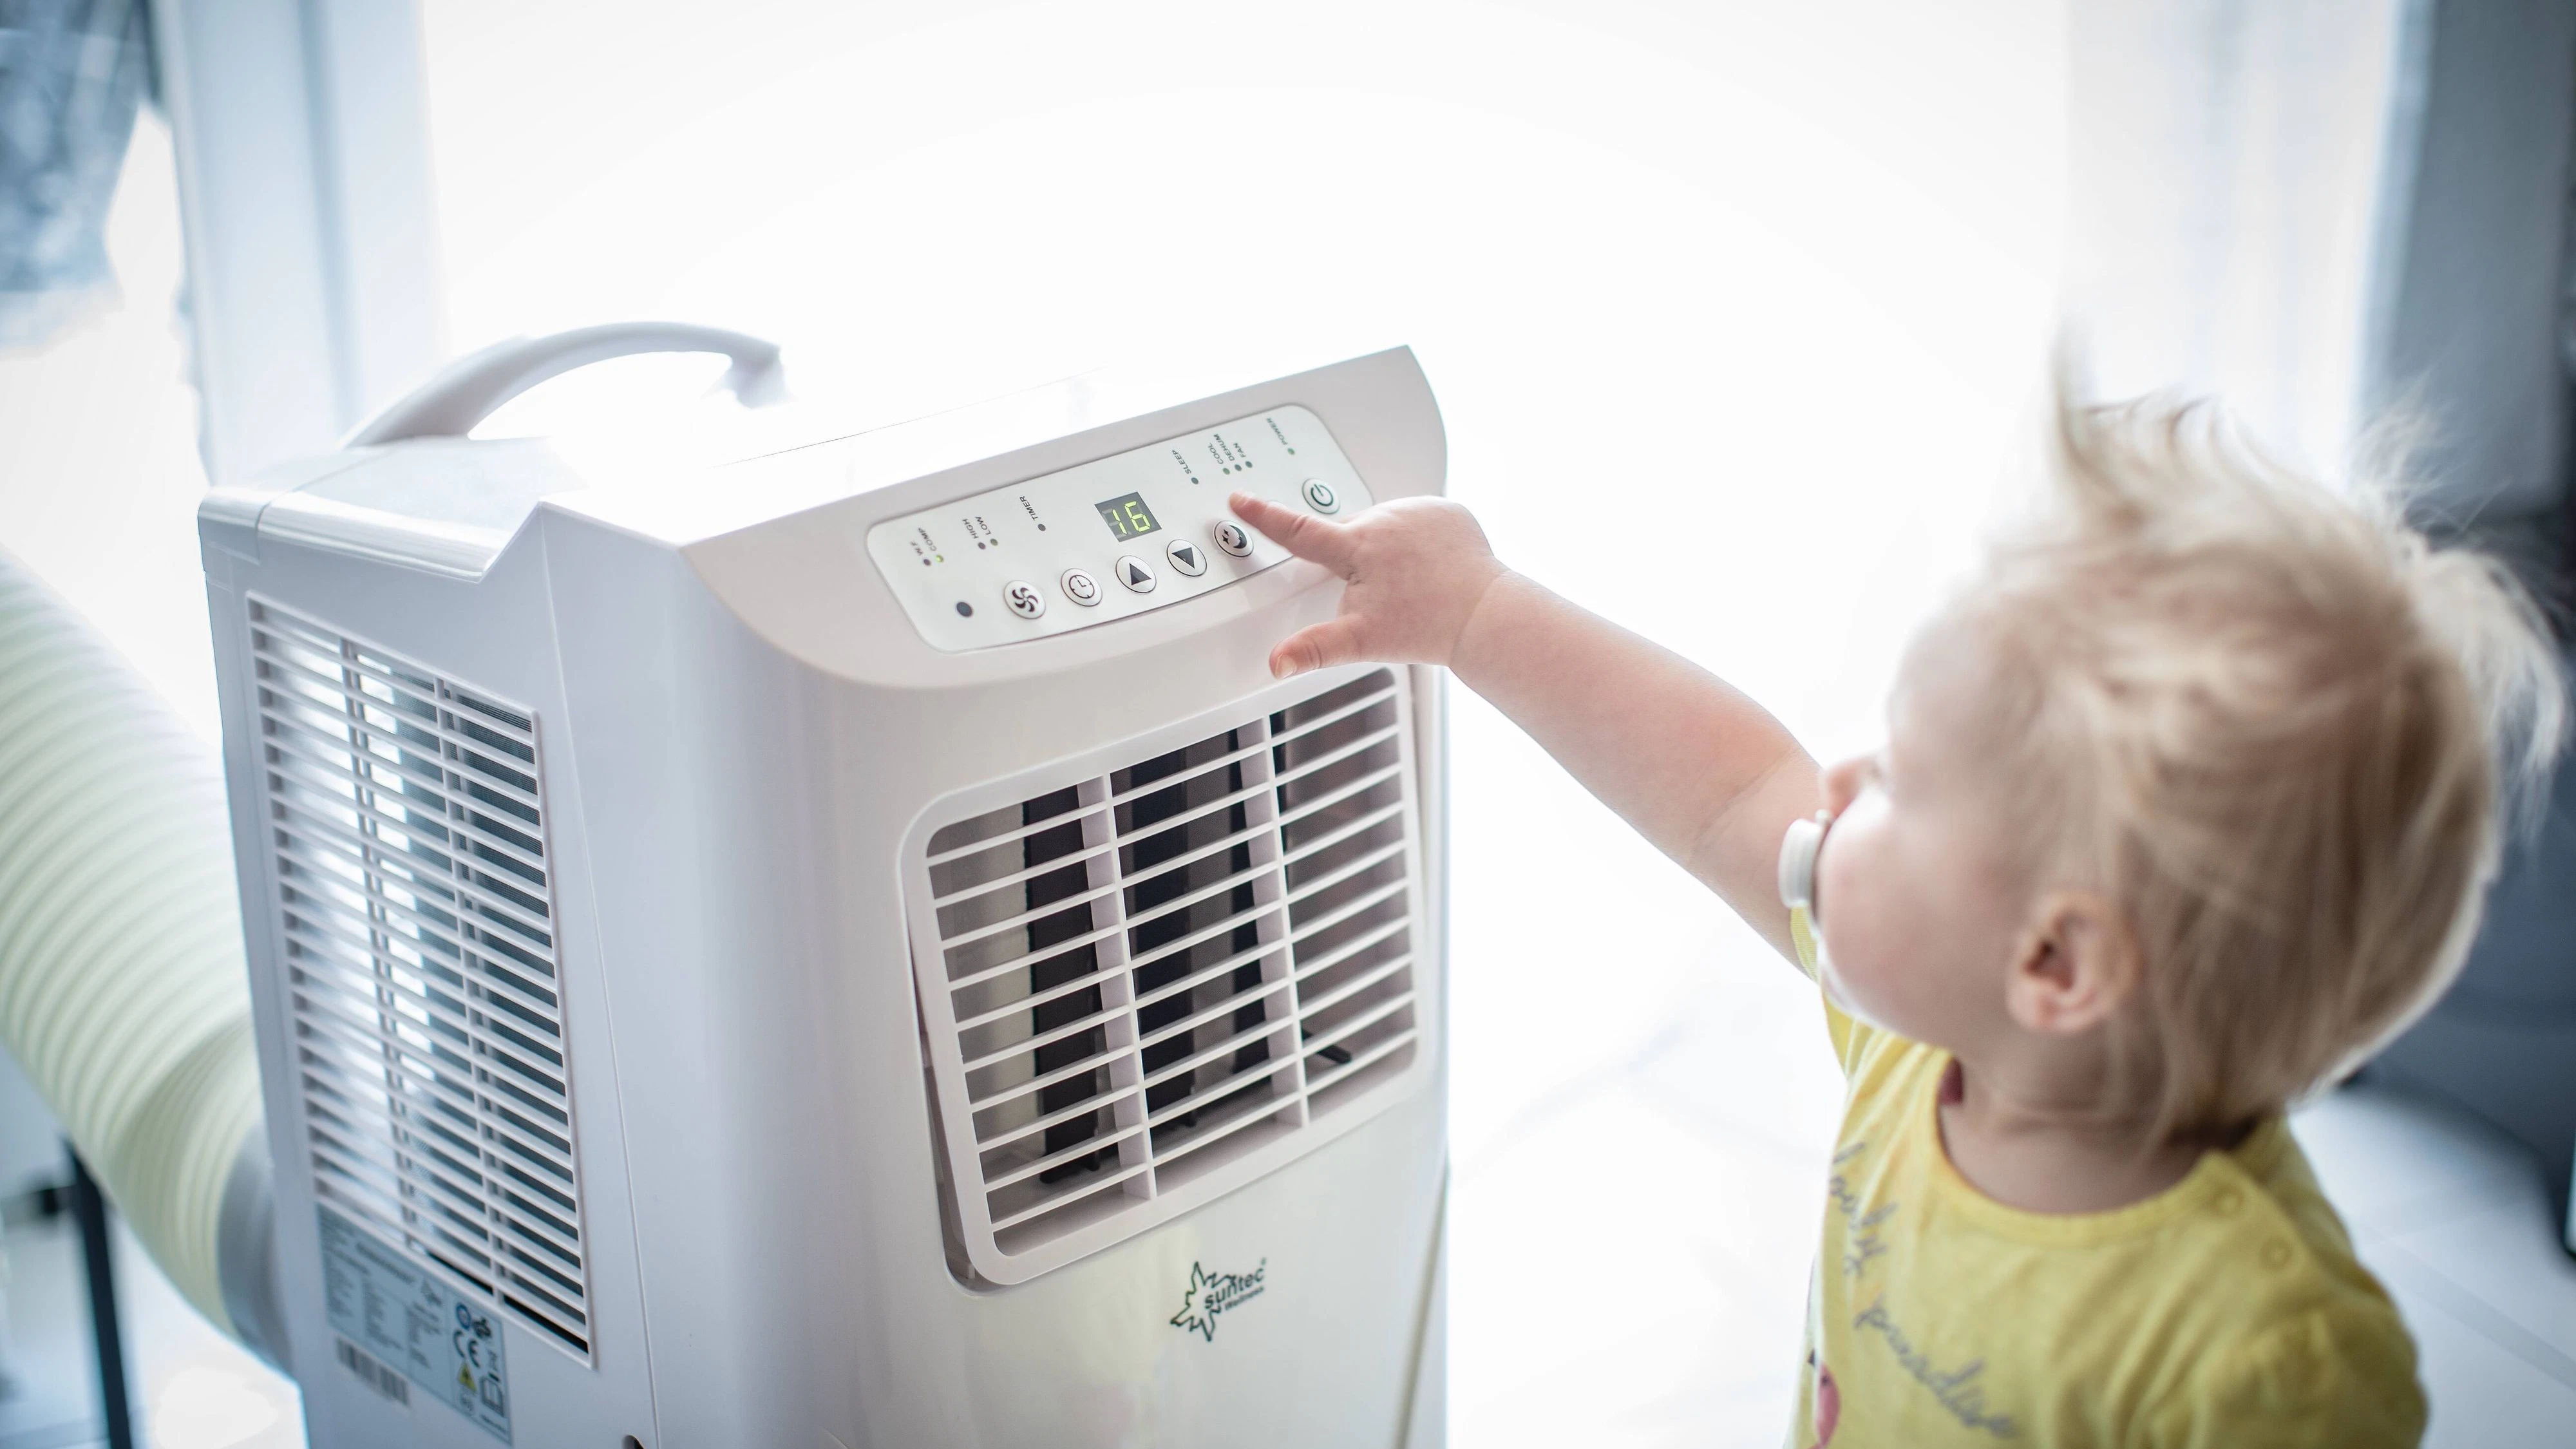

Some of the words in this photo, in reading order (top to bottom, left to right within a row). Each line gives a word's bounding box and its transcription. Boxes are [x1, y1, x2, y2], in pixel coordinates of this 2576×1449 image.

[1266, 417, 1287, 445] POWER
[1208, 442, 1224, 464] COOL
[1213, 433, 1235, 461] DEHUM
[1233, 442, 1246, 458] FAN
[1172, 450, 1191, 474] SLEEP
[1019, 495, 1038, 520] TIMER
[1112, 501, 1151, 535] 16
[962, 518, 979, 539] HIGH
[975, 516, 991, 535] LOW
[918, 527, 937, 551] COMP
[1204, 1268, 1264, 1309] suntec
